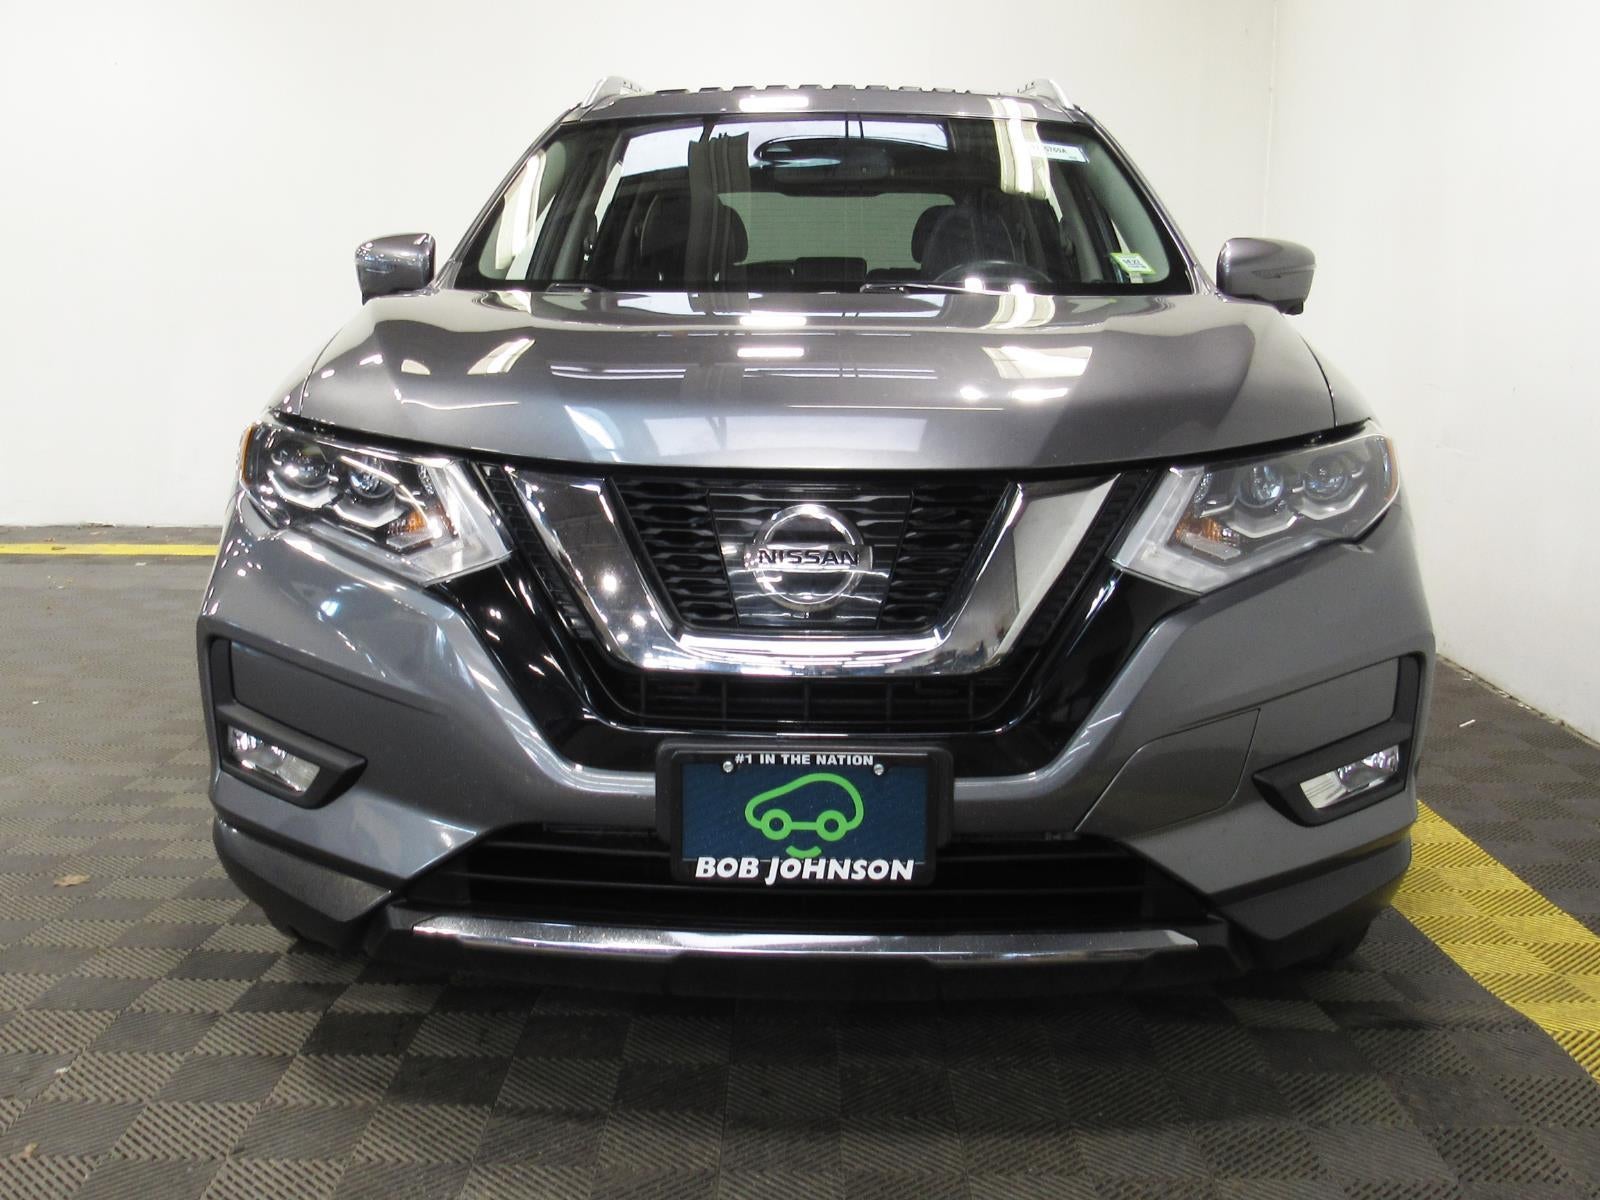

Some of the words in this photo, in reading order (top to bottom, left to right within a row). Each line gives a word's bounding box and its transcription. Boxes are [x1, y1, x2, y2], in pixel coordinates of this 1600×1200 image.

[758, 548, 860, 566] NISSAN
[734, 753, 753, 765] #1
[759, 753, 777, 765] IN
[780, 753, 811, 766] THE
[815, 753, 874, 767] NATION
[695, 856, 760, 879] BOB
[764, 857, 915, 886] JOHNSON
